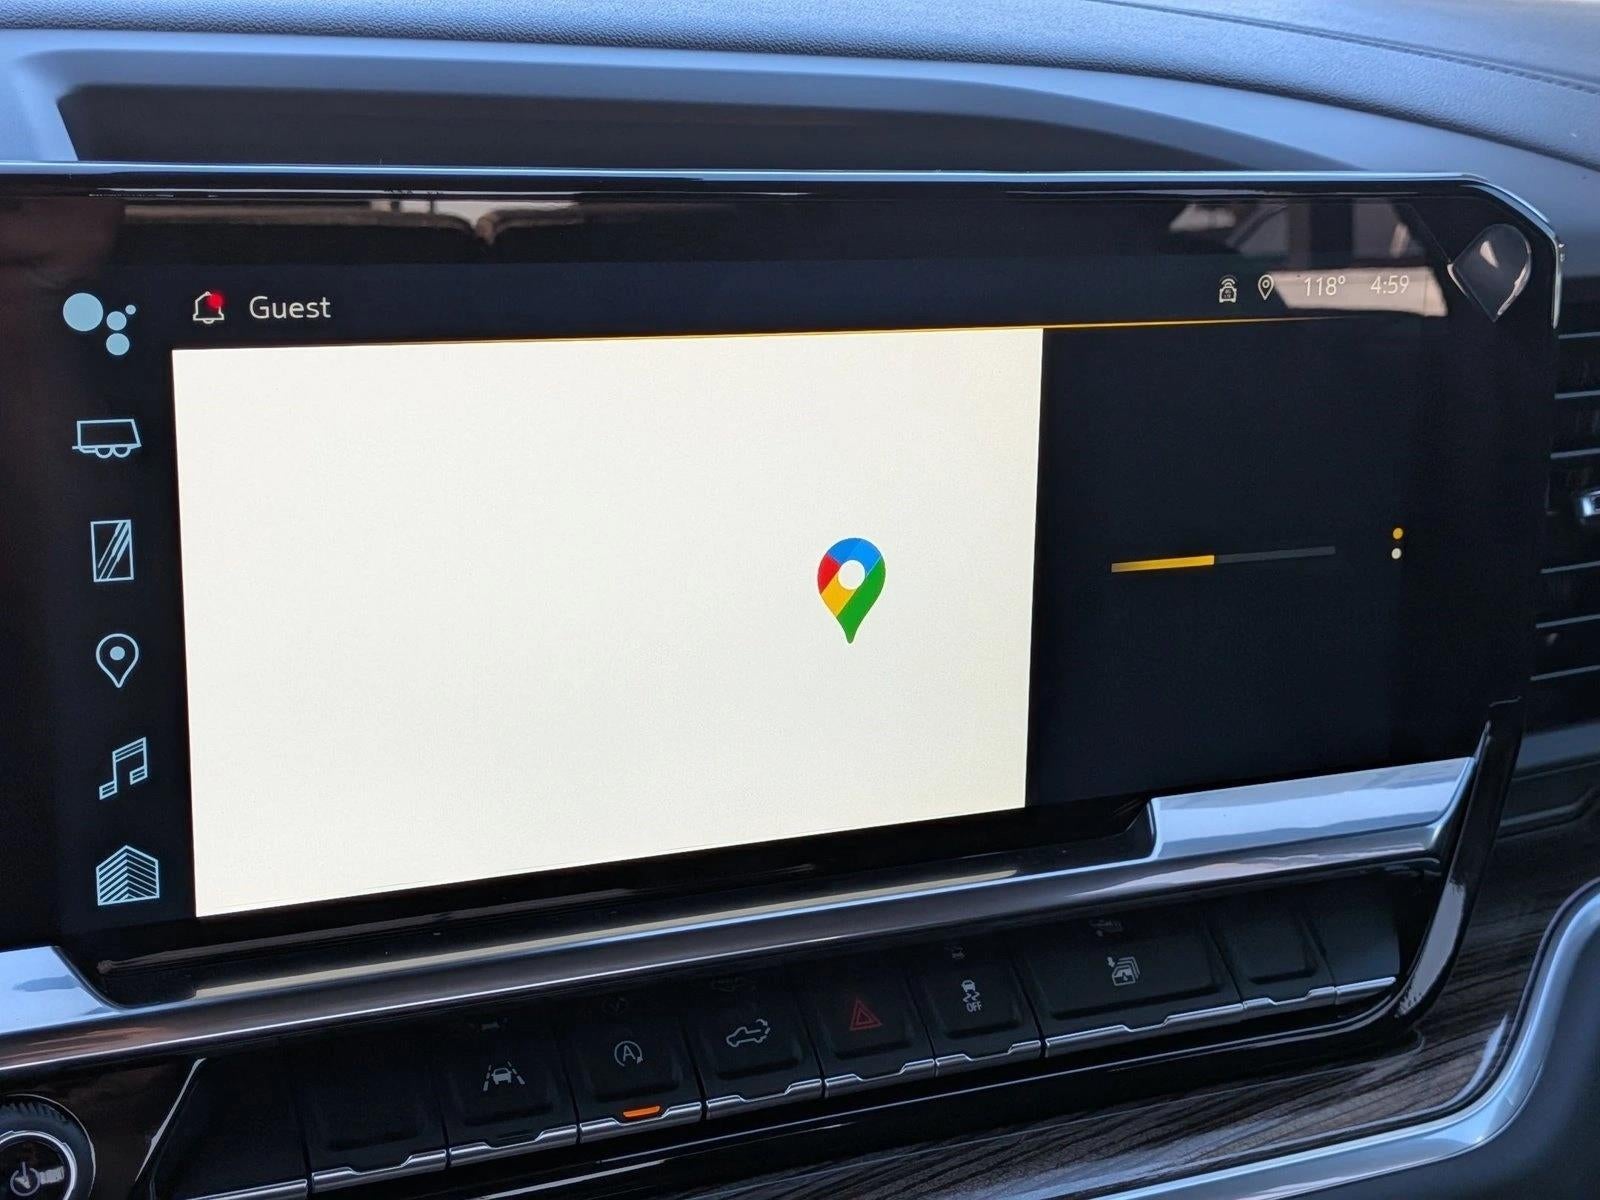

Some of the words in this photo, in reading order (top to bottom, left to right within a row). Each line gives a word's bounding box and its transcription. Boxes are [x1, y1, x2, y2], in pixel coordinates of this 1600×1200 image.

[1370, 275, 1409, 294] 4:59
[249, 295, 332, 319] Guest
[966, 1001, 982, 1013] OFF
